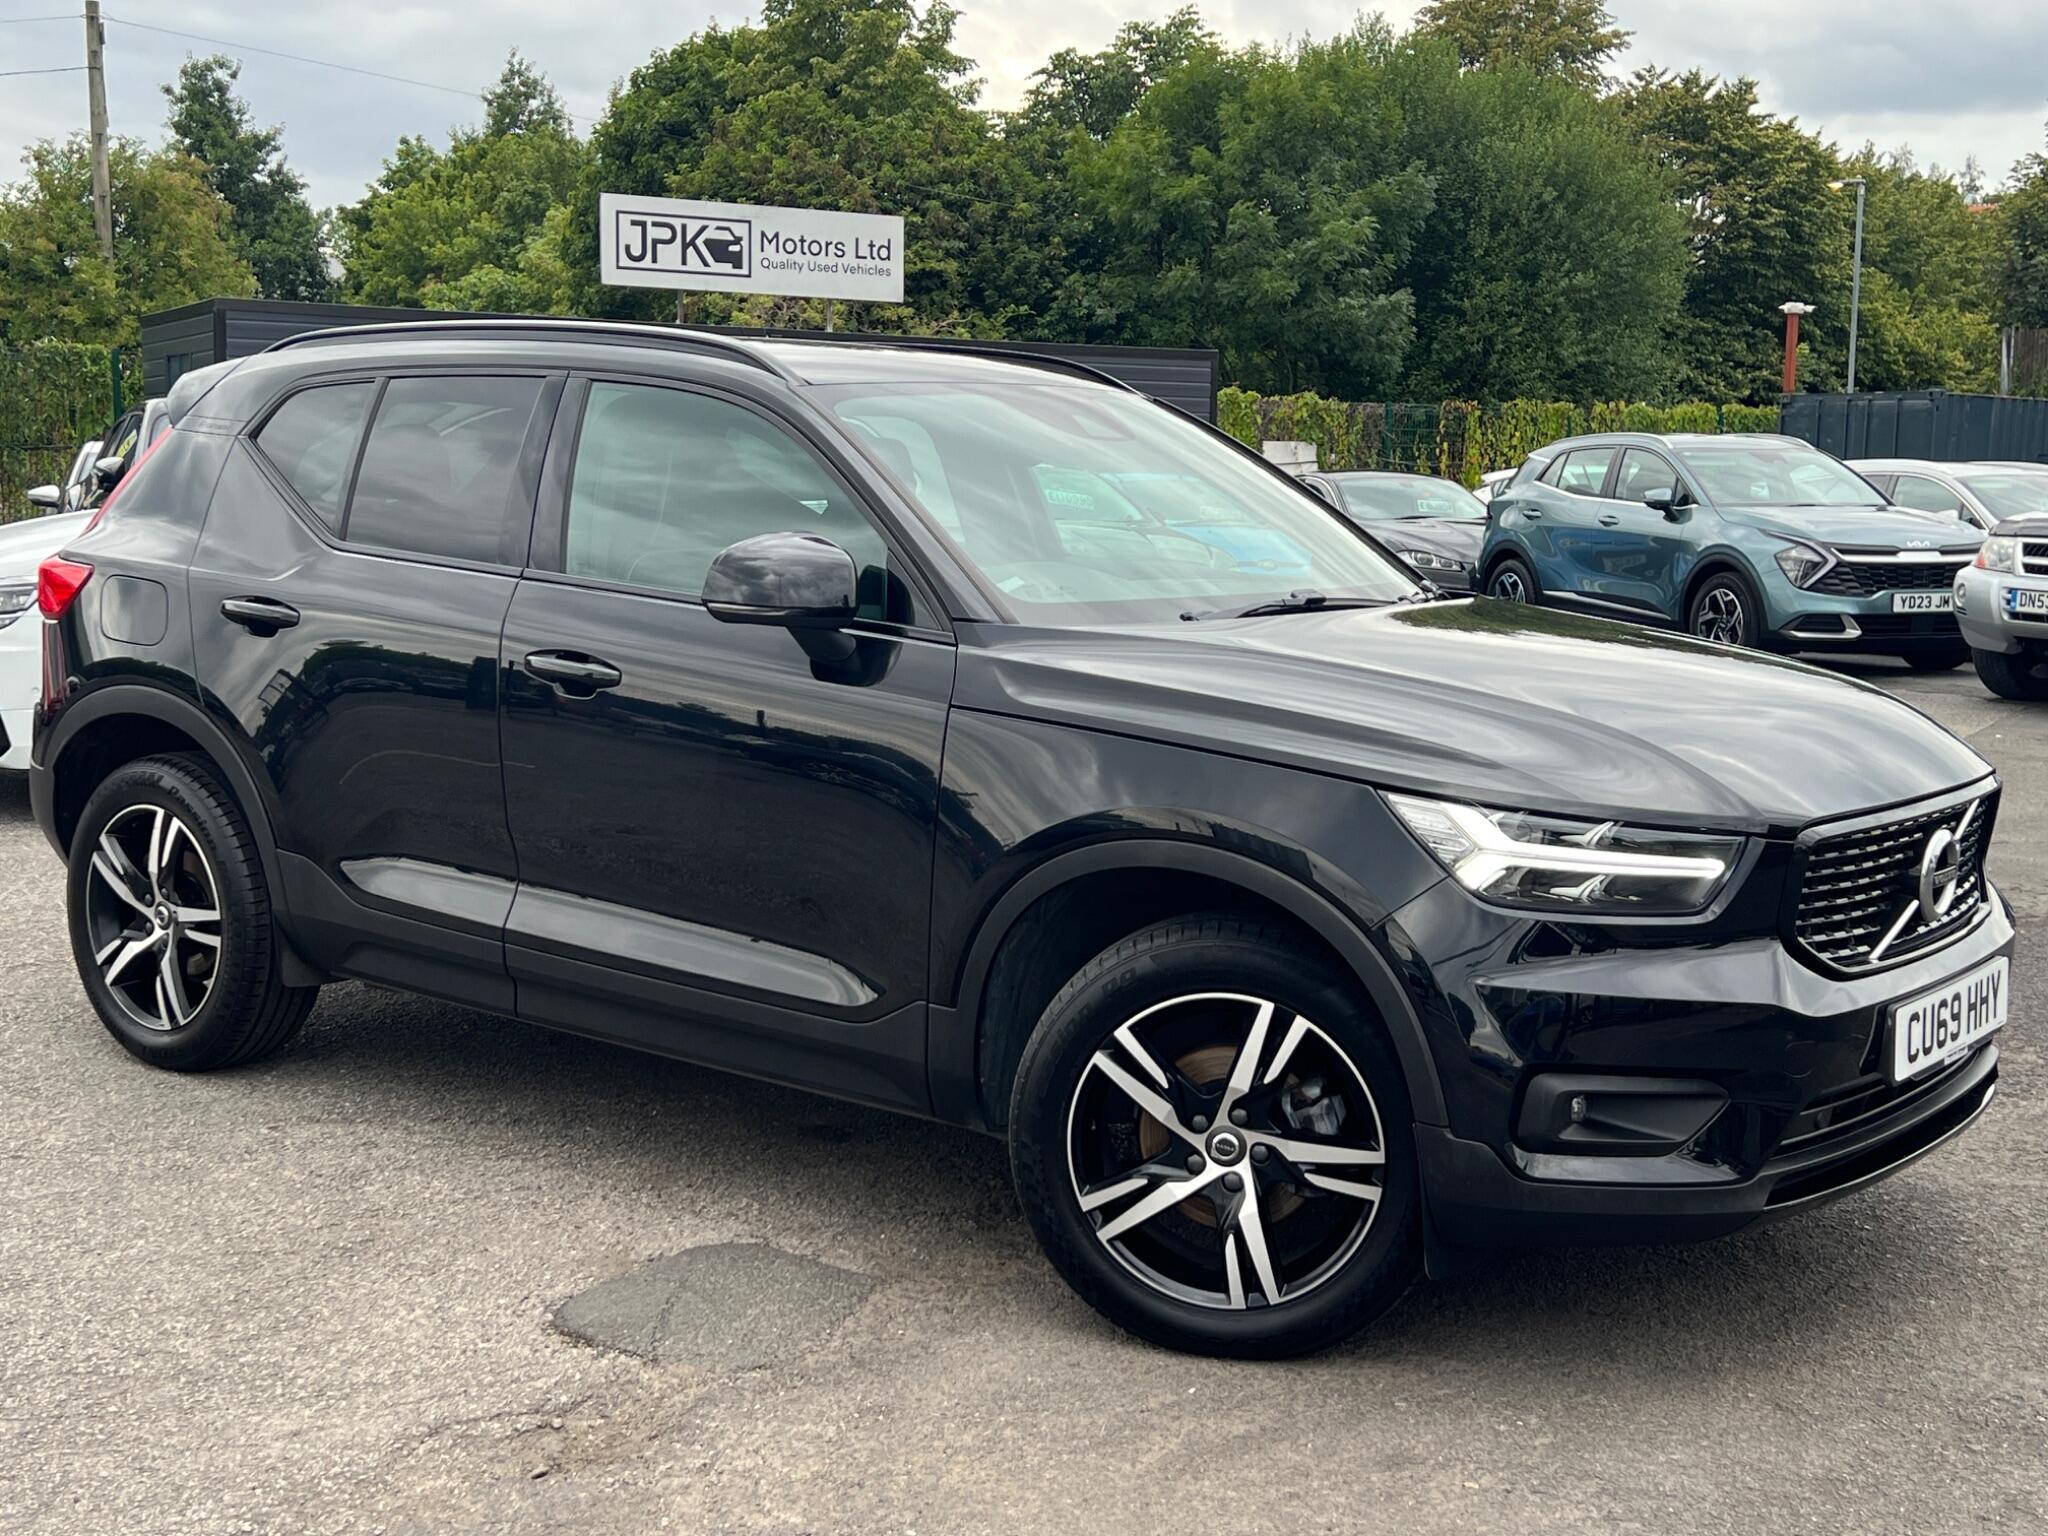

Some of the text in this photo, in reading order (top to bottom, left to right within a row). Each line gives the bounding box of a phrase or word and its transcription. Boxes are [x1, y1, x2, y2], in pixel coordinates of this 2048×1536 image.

[624, 219, 711, 268] JPK
[760, 230, 892, 262] Motors Ltd
[760, 257, 892, 277] Quality Used Vehicles
[1900, 595, 1951, 609] YD23 JM
[1907, 969, 2001, 1064] CU69 HHY
